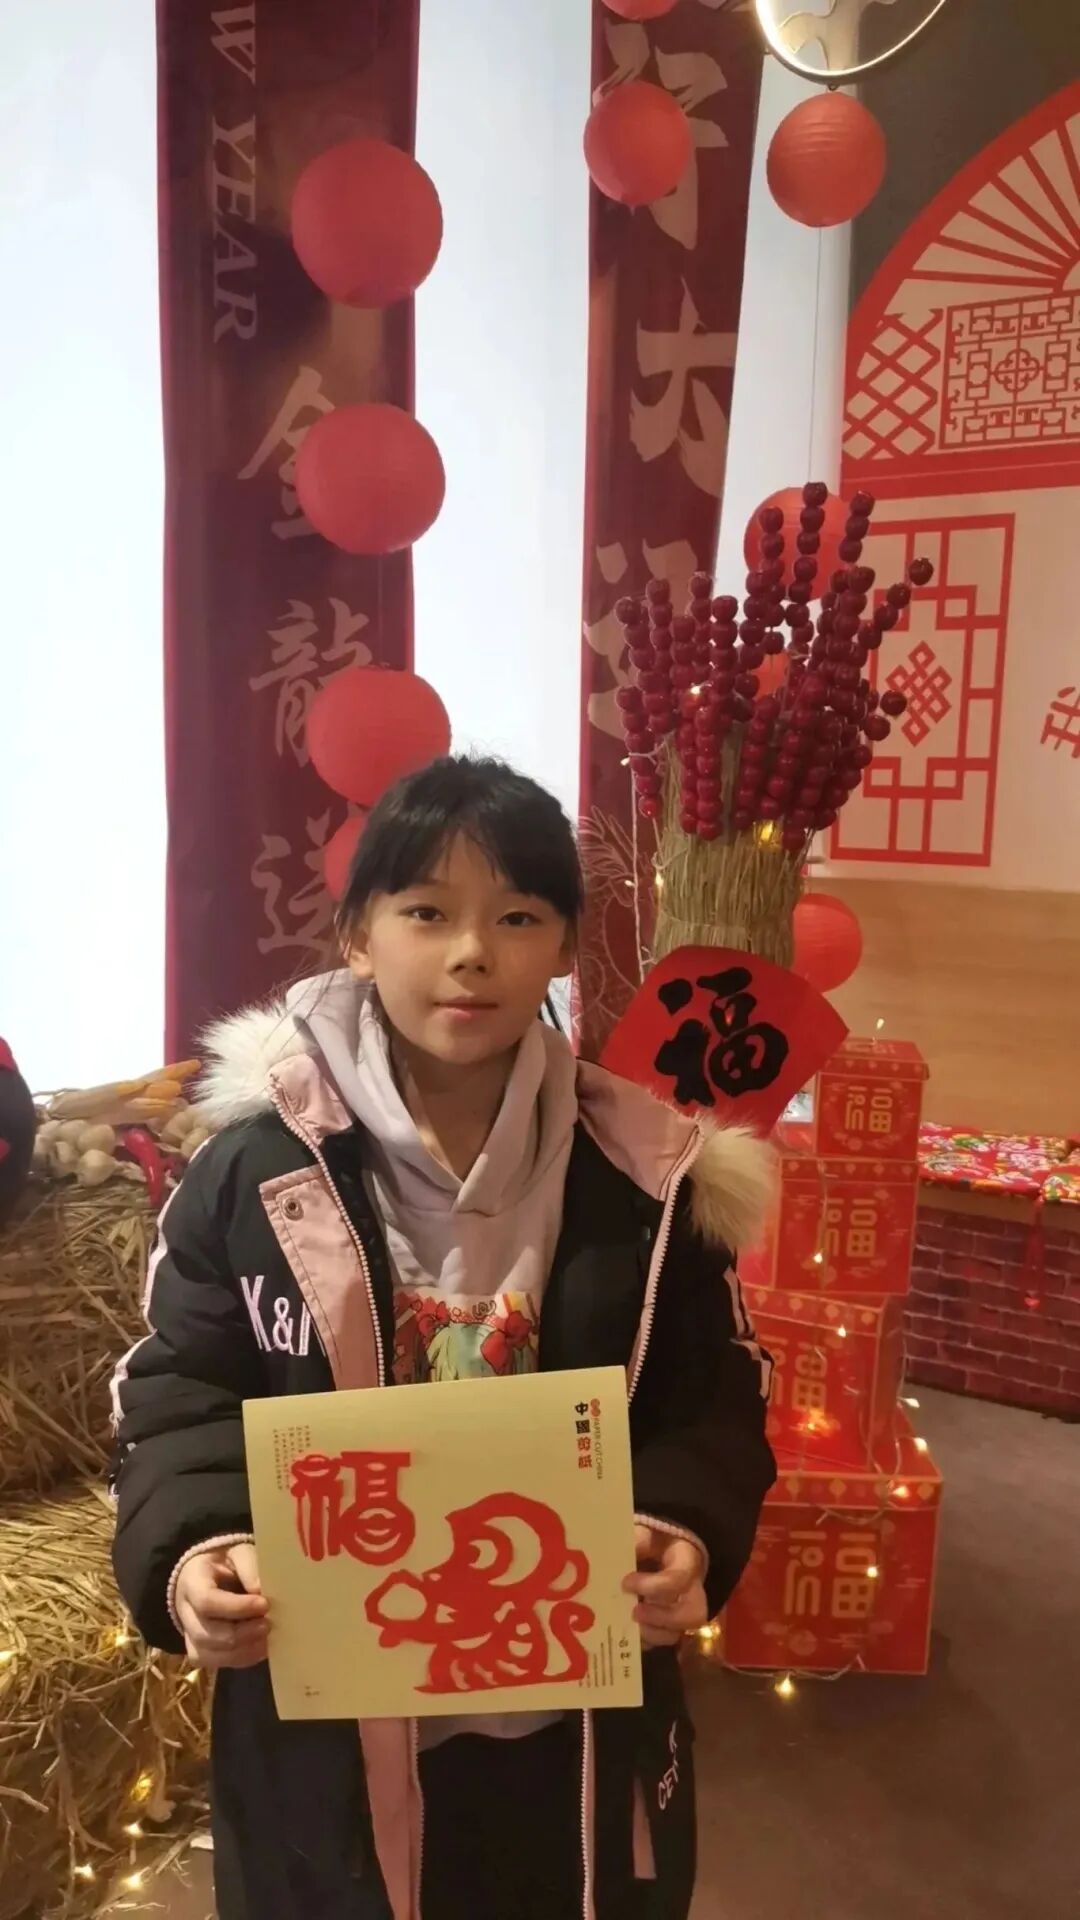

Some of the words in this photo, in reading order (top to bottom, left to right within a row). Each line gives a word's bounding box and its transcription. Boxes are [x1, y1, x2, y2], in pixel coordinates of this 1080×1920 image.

[212, 114, 258, 344] YEAR
[654, 967, 789, 1107] 福
[844, 1085, 893, 1134] 福
[784, 1530, 878, 1619] 福
